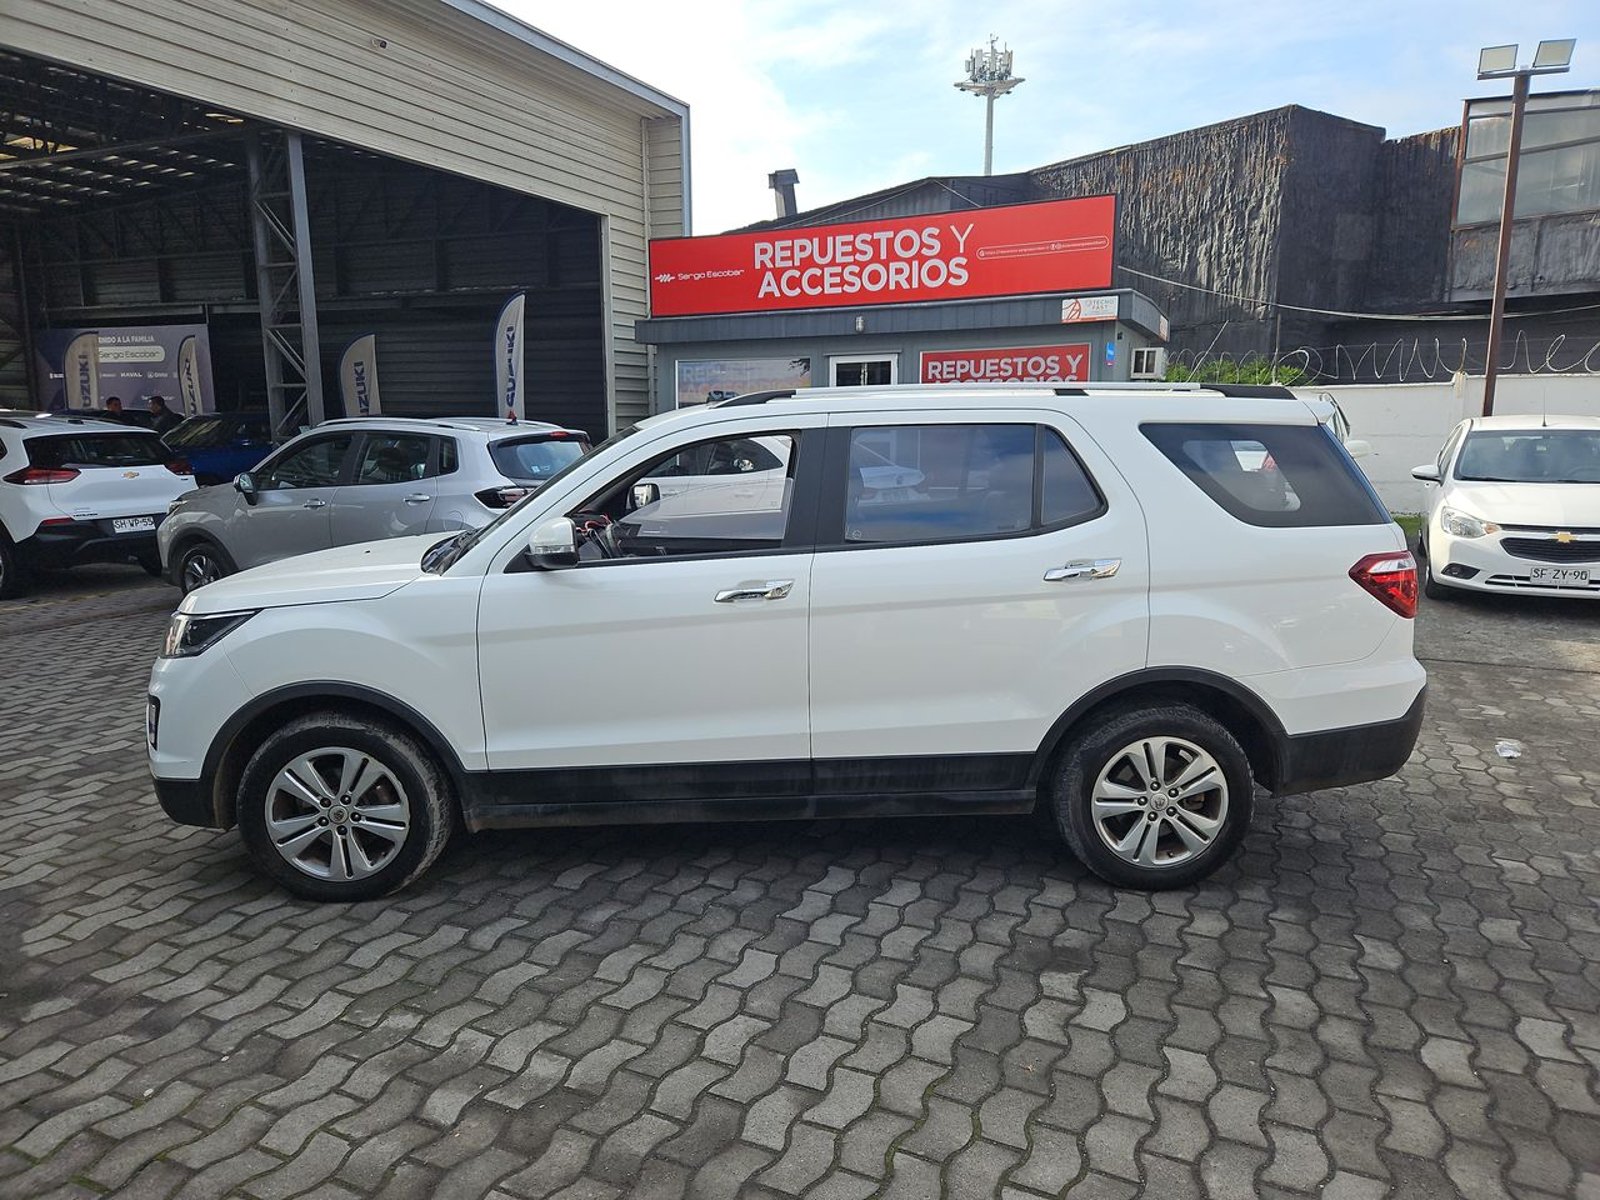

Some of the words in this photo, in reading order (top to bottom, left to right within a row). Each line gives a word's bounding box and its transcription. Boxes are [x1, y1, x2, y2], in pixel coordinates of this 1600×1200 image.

[754, 227, 941, 269] REPUESTOS
[949, 223, 975, 254] Y
[677, 272, 706, 281] Sergo
[706, 269, 745, 279] Escobar
[757, 256, 969, 298] ACCESORIOS
[122, 335, 131, 343] LA
[131, 335, 155, 343] FAMILIA
[125, 350, 161, 358] Escobar
[927, 355, 1060, 380] REPUESTOS
[1066, 353, 1084, 373] Y
[1532, 568, 1548, 578] SF
